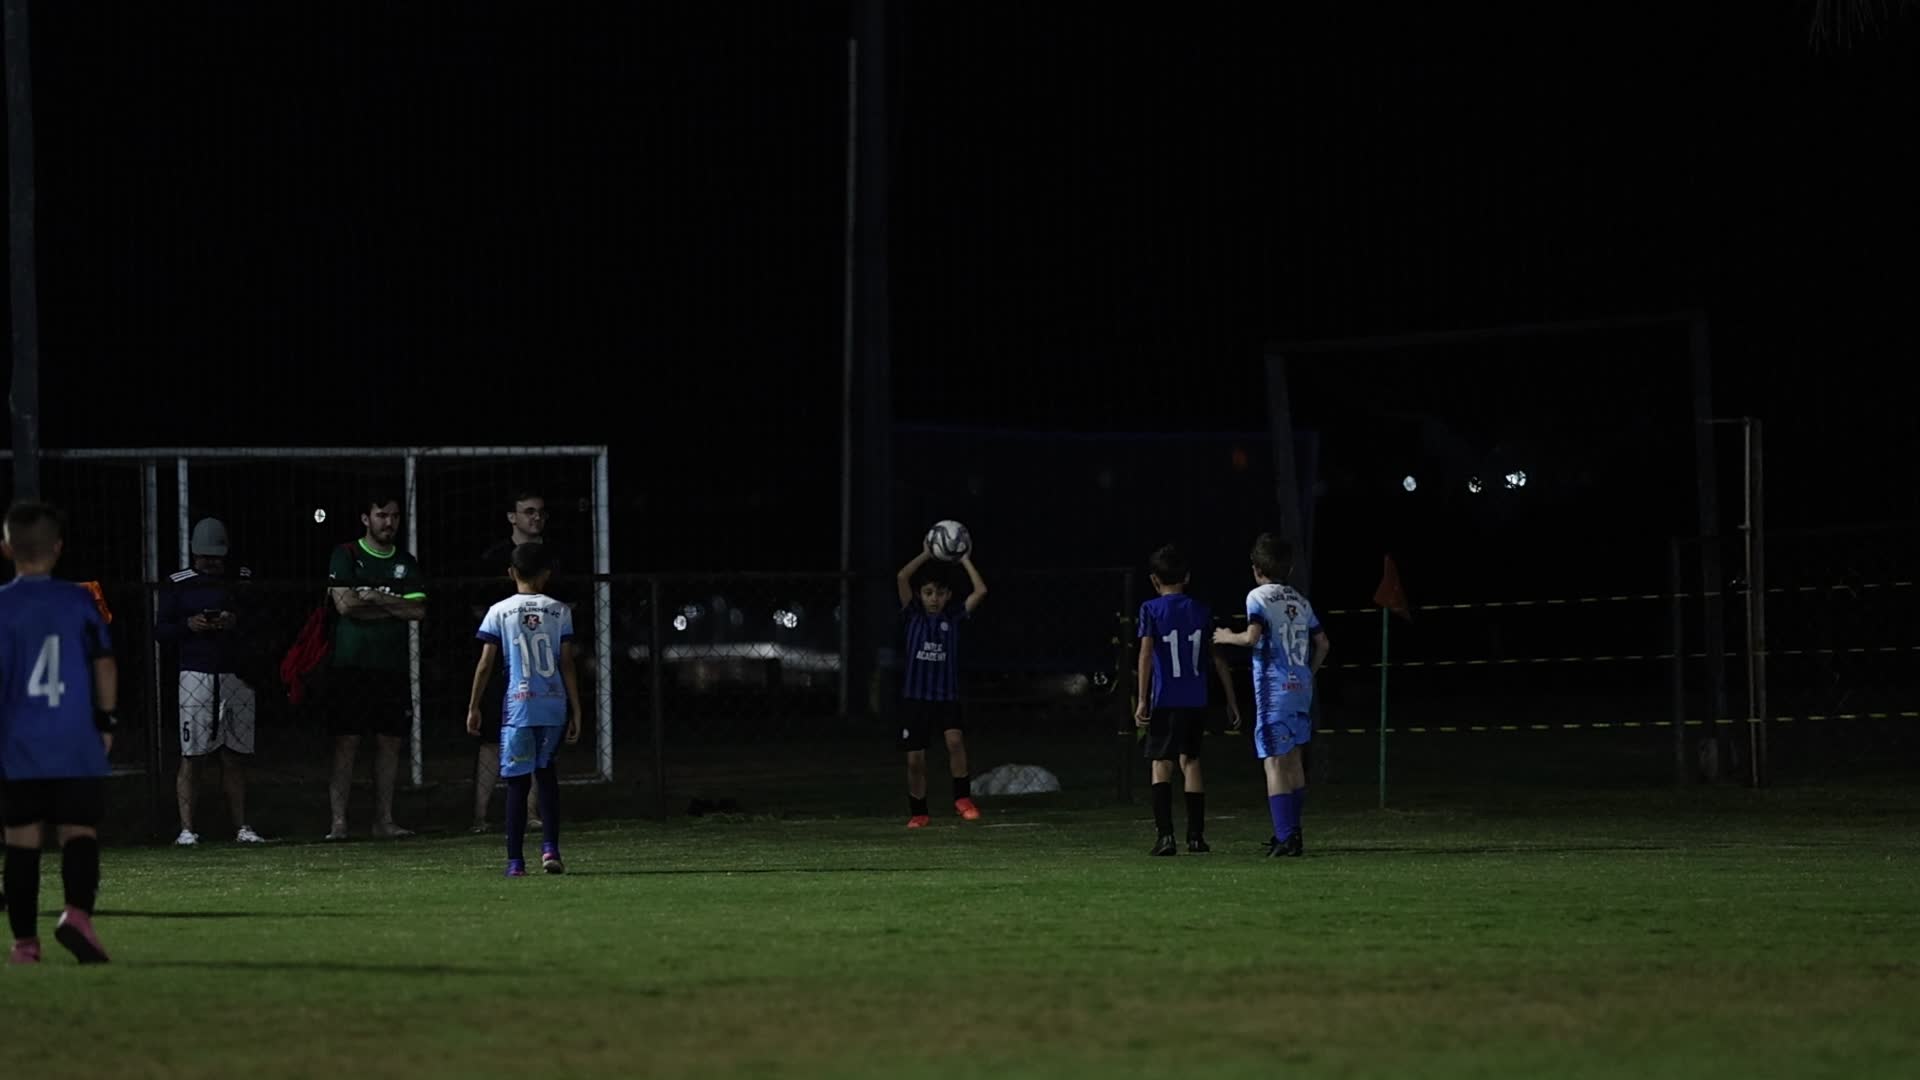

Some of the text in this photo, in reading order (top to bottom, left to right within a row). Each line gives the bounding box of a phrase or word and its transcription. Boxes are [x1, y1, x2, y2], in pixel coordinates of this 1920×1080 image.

[513, 632, 555, 678] 10
[1161, 628, 1202, 678] 11
[1279, 622, 1308, 666] 15
[27, 634, 66, 708] 4
[183, 721, 190, 742] 6
